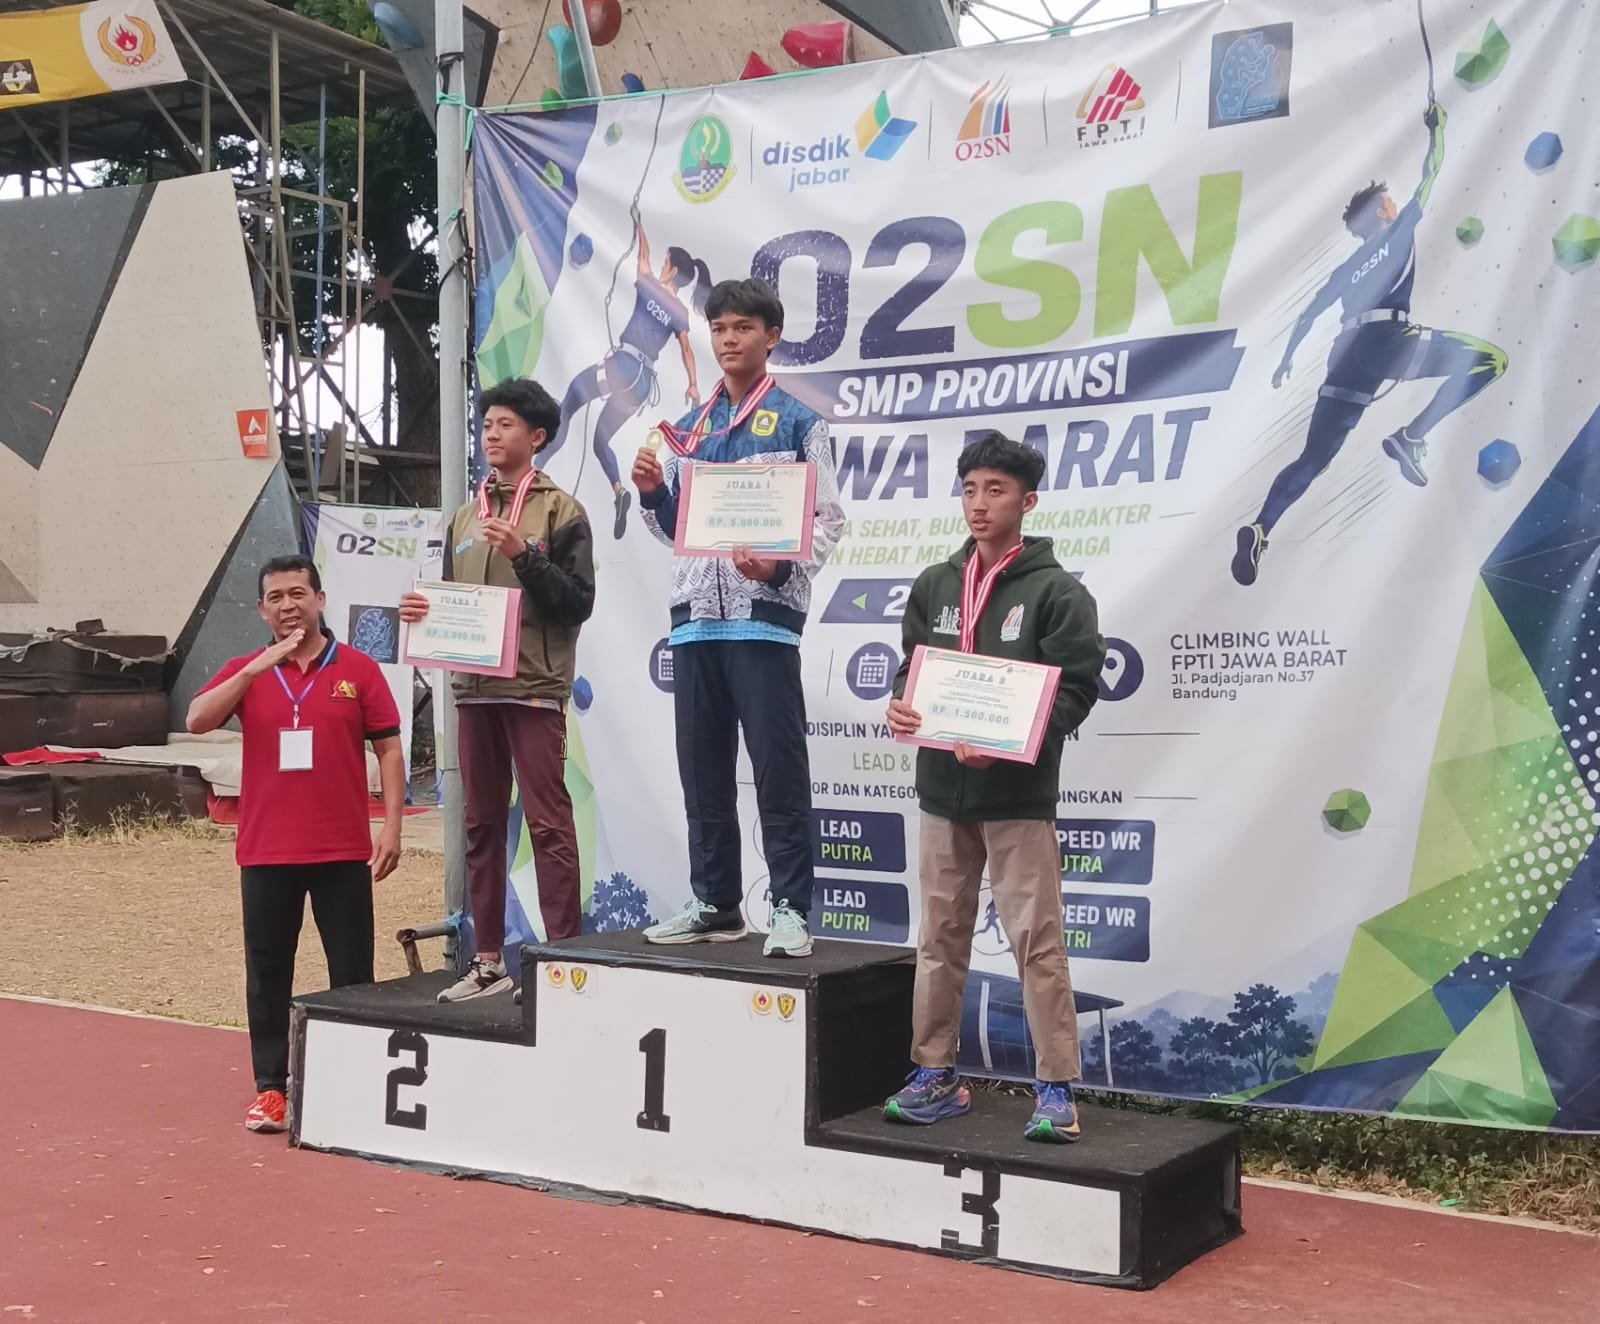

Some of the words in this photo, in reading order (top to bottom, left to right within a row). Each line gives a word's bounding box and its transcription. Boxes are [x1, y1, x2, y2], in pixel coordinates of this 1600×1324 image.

[763, 134, 851, 165] disdik
[955, 135, 1010, 161] O2SN
[789, 167, 851, 193] jabar
[833, 374, 922, 417] SMP
[929, 350, 1130, 412] PROVINSI
[829, 433, 929, 501] WA
[726, 481, 762, 490] JUARA
[859, 518, 922, 540] SEHAT,
[929, 516, 971, 536] BUG
[1022, 503, 1151, 531] ERKARAKTER
[428, 549, 443, 558] JA
[849, 546, 912, 565] HEBAT
[1055, 536, 1110, 558] RAGA
[1170, 632, 1270, 650] CLIMBING
[1276, 629, 1331, 647] WALL
[1171, 653, 1214, 670] FPTI
[1220, 651, 1278, 669] JAWA
[1283, 649, 1347, 668] BARAT
[954, 669, 994, 683] JUARA
[1191, 671, 1273, 687] Padjadjaran
[1277, 670, 1315, 683] No.37
[1172, 687, 1237, 701] Bandung
[807, 722, 866, 738] DISIPLIN
[853, 752, 895, 771] LEAD
[901, 754, 912, 772] &
[833, 783, 860, 797] DAN
[864, 785, 920, 799] KATEGO
[1058, 790, 1123, 804] INGKAN
[820, 820, 862, 839] LEAD
[1056, 830, 1106, 850] PEED
[1111, 831, 1142, 851] WR
[821, 843, 873, 862] PUTRA
[1060, 854, 1104, 873] UTRA
[823, 889, 867, 909] LEAD
[1105, 906, 1137, 927] WR
[821, 912, 871, 932] PUTRI
[1064, 929, 1092, 949] TRI
[385, 1029, 429, 1131] 2
[637, 1028, 671, 1133] 1
[940, 1155, 1001, 1258] 3
